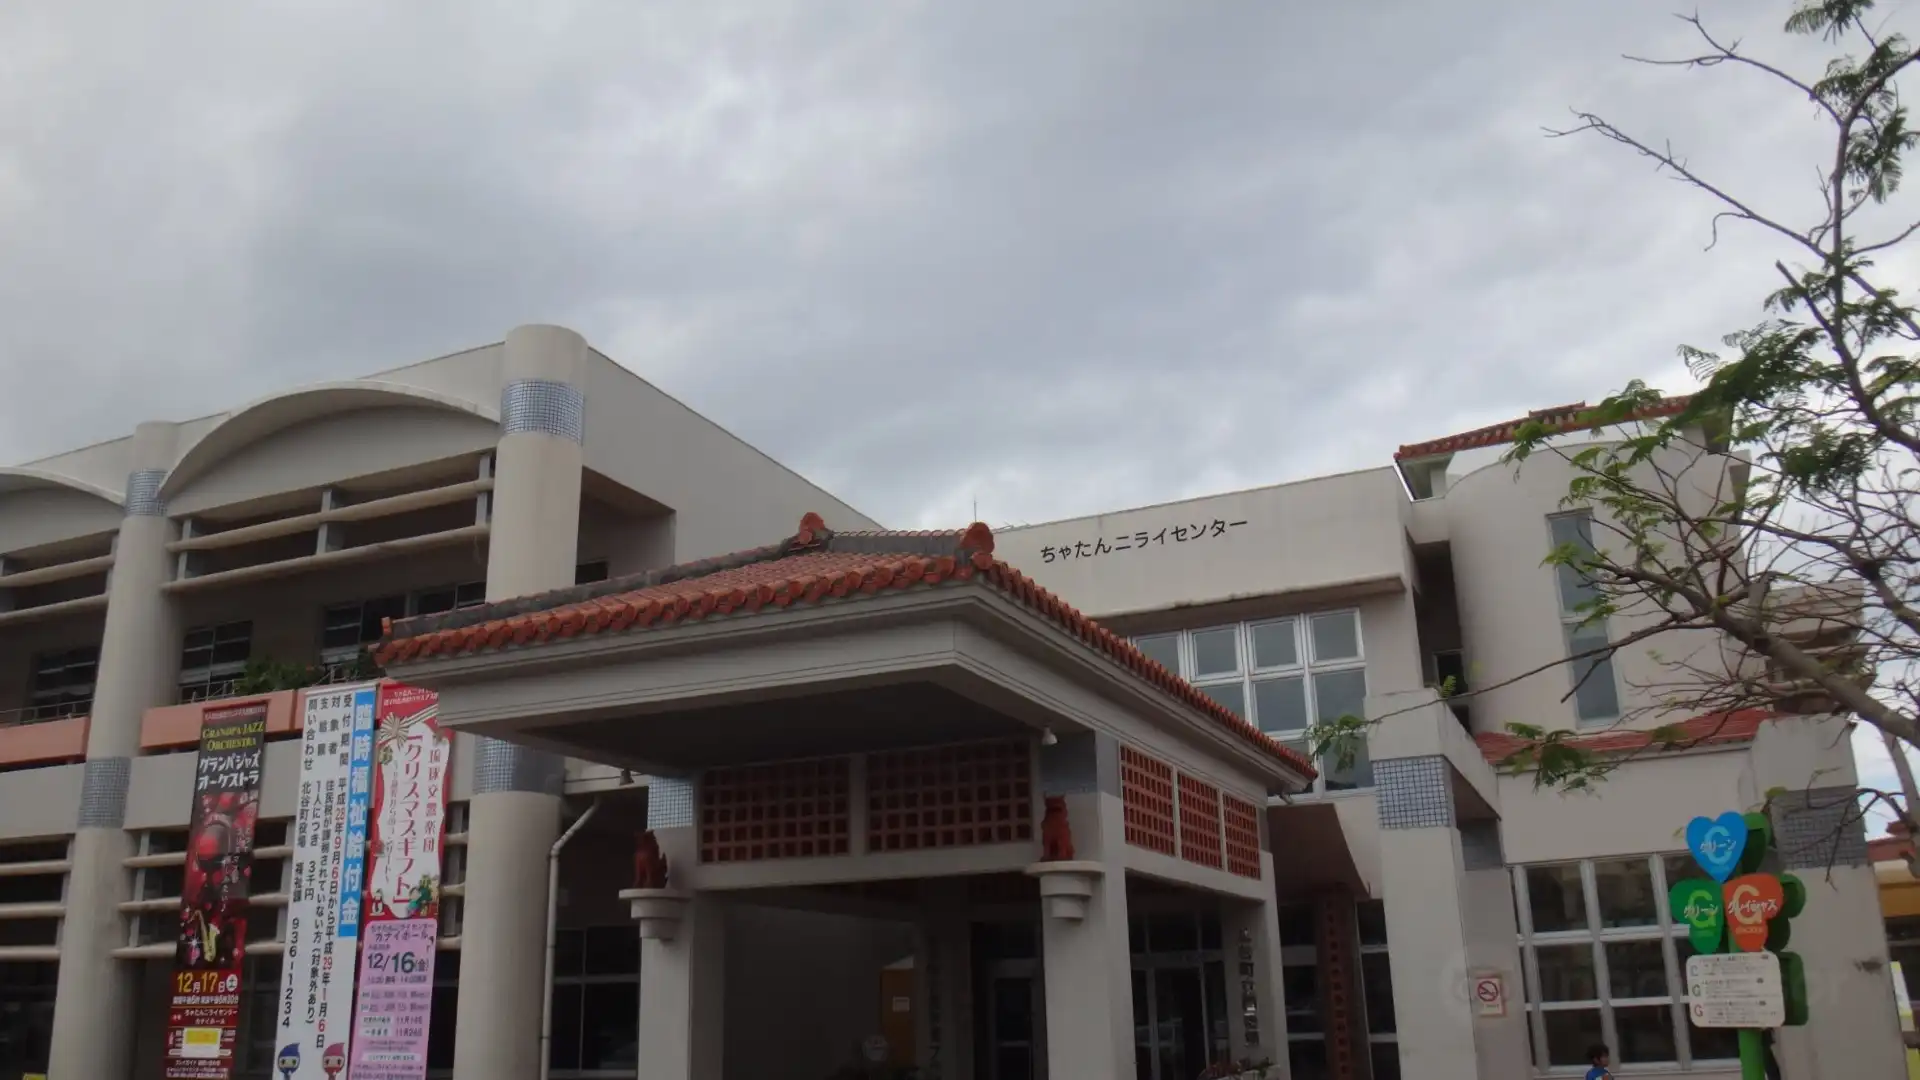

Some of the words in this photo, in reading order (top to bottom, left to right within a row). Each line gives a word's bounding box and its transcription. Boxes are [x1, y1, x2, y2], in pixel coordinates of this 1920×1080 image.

[1040, 519, 1248, 563] ちゃたんニライセンター
[243, 721, 265, 734] JAZZ
[304, 699, 318, 771] 問い合わせ
[197, 770, 259, 791] オーケストラ
[199, 750, 262, 773] グランパジャズ
[304, 861, 316, 901] 3千円
[1689, 890, 1716, 928] G
[1733, 884, 1763, 925] G
